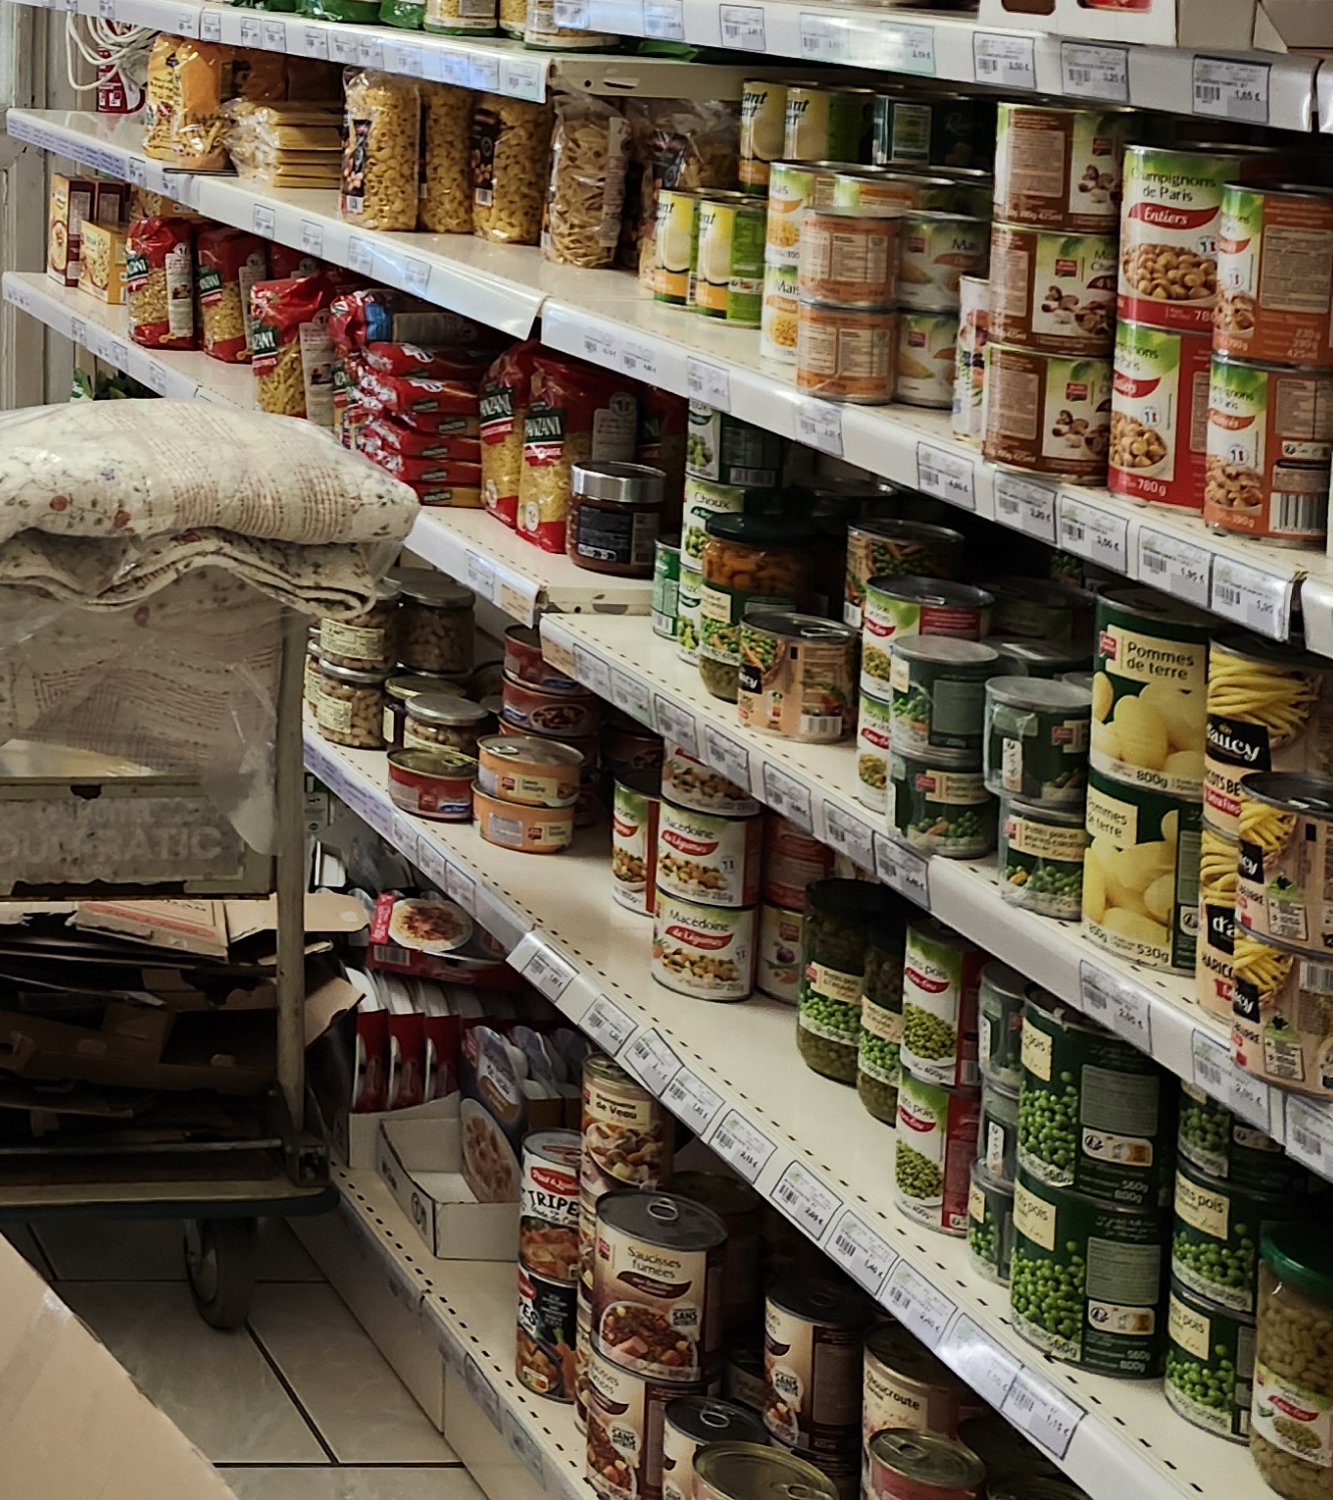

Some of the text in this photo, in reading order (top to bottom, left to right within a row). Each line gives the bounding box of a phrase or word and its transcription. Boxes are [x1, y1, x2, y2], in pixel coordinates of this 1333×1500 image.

[1143, 186, 1194, 202] de Paris
[1144, 206, 1188, 225] Entiers
[1127, 640, 1195, 667] Pommes
[1126, 655, 1188, 681] de terre
[1136, 769, 1168, 790] 800g
[669, 908, 730, 933] Macédoine
[1136, 942, 1170, 964] 530g
[608, 1105, 638, 1121] Veau
[528, 1189, 581, 1215] TRIPE
[627, 1244, 682, 1270] Saucisses
[671, 1309, 698, 1321] SANS
[866, 1368, 921, 1411] Choucroute
